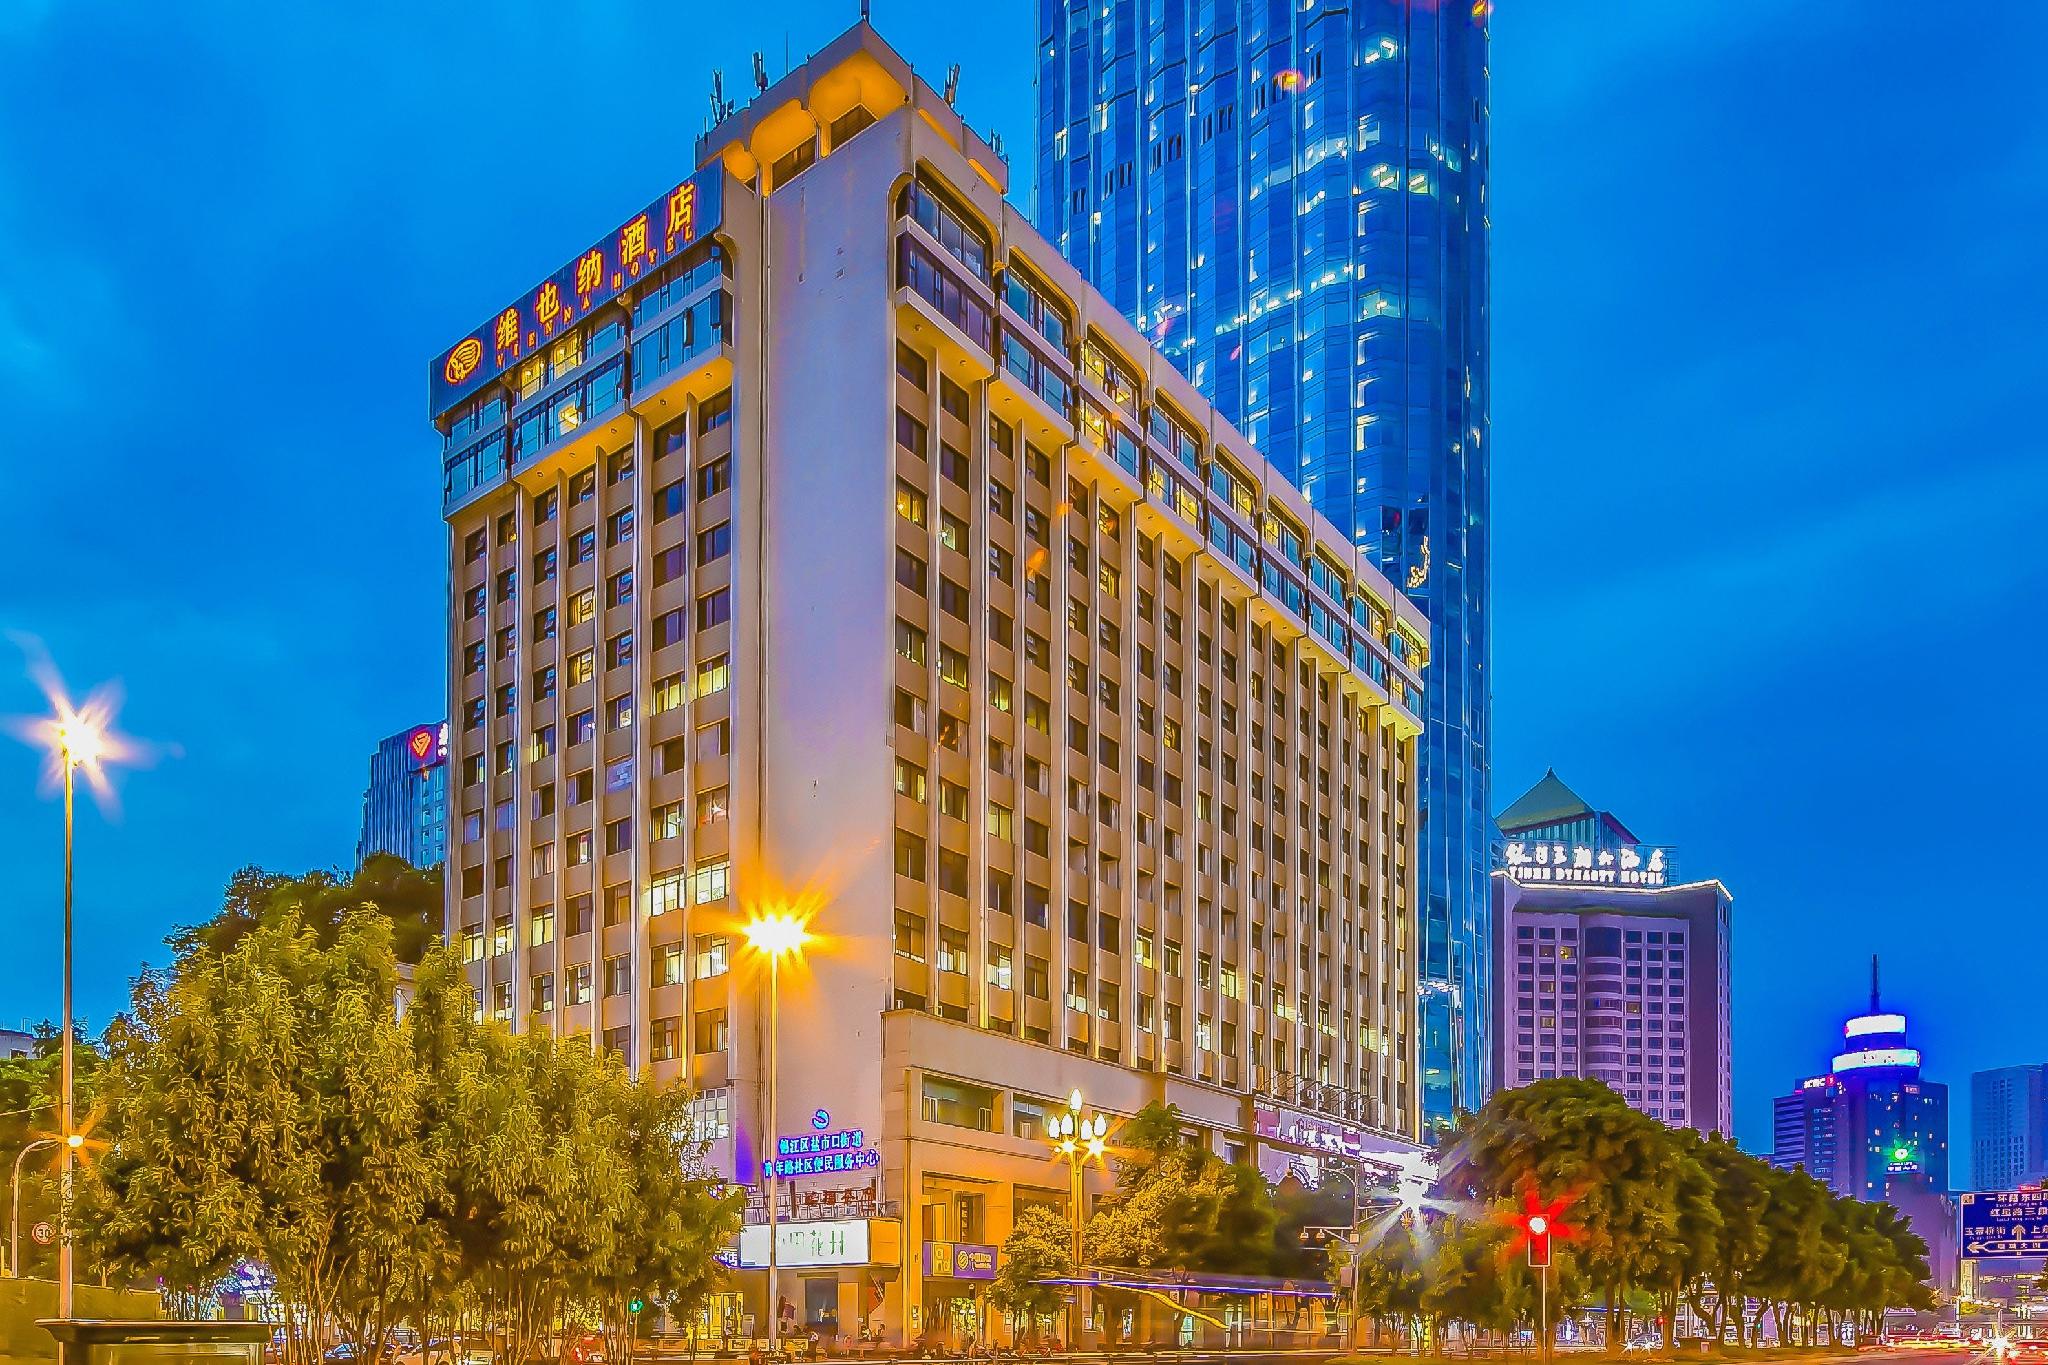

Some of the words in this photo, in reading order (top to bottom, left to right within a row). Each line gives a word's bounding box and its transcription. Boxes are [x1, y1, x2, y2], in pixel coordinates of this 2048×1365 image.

[496, 183, 695, 350] 维也纳酒店
[613, 224, 694, 290] HOTEL
